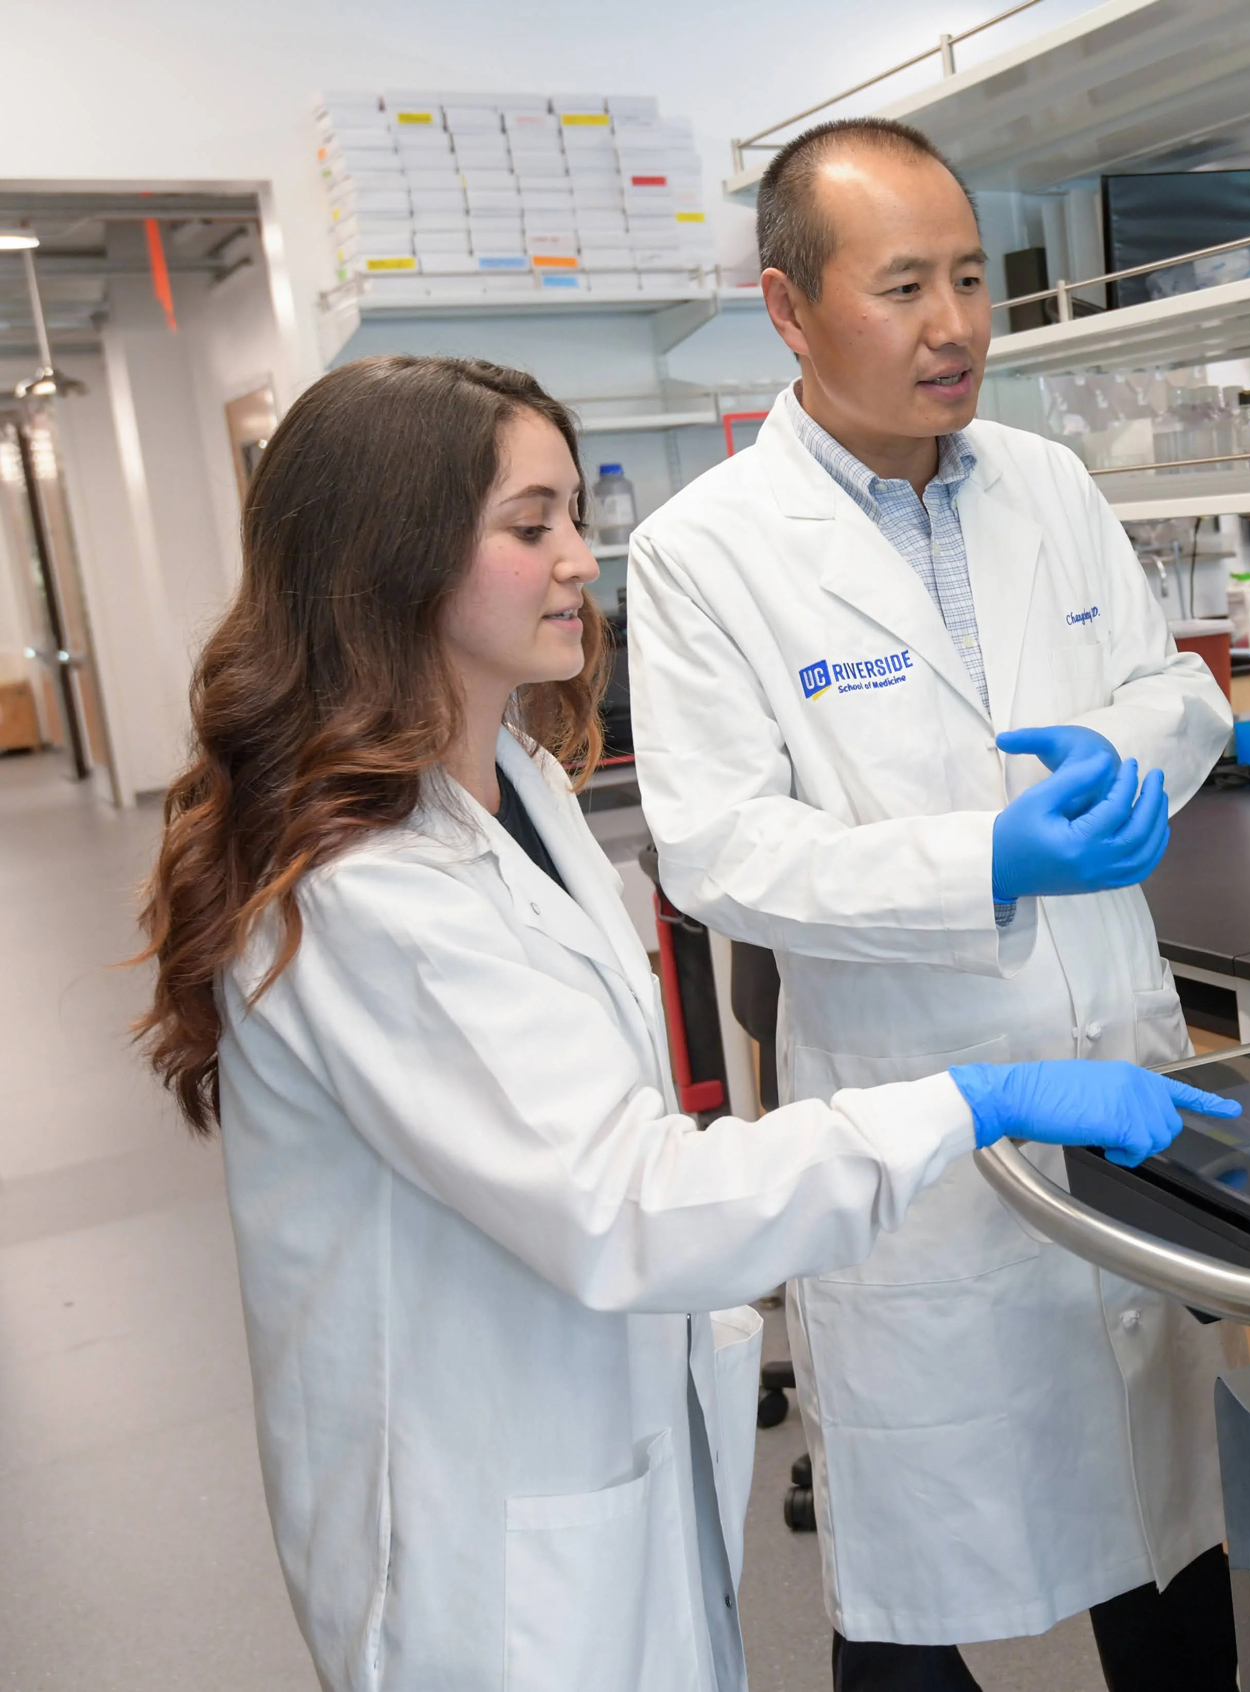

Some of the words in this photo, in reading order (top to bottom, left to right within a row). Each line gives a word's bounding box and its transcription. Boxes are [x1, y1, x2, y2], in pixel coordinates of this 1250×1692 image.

[831, 649, 914, 682] RIVERSIDE
[837, 682, 863, 694] School
[864, 681, 872, 690] of
[872, 674, 907, 689] Medicine
